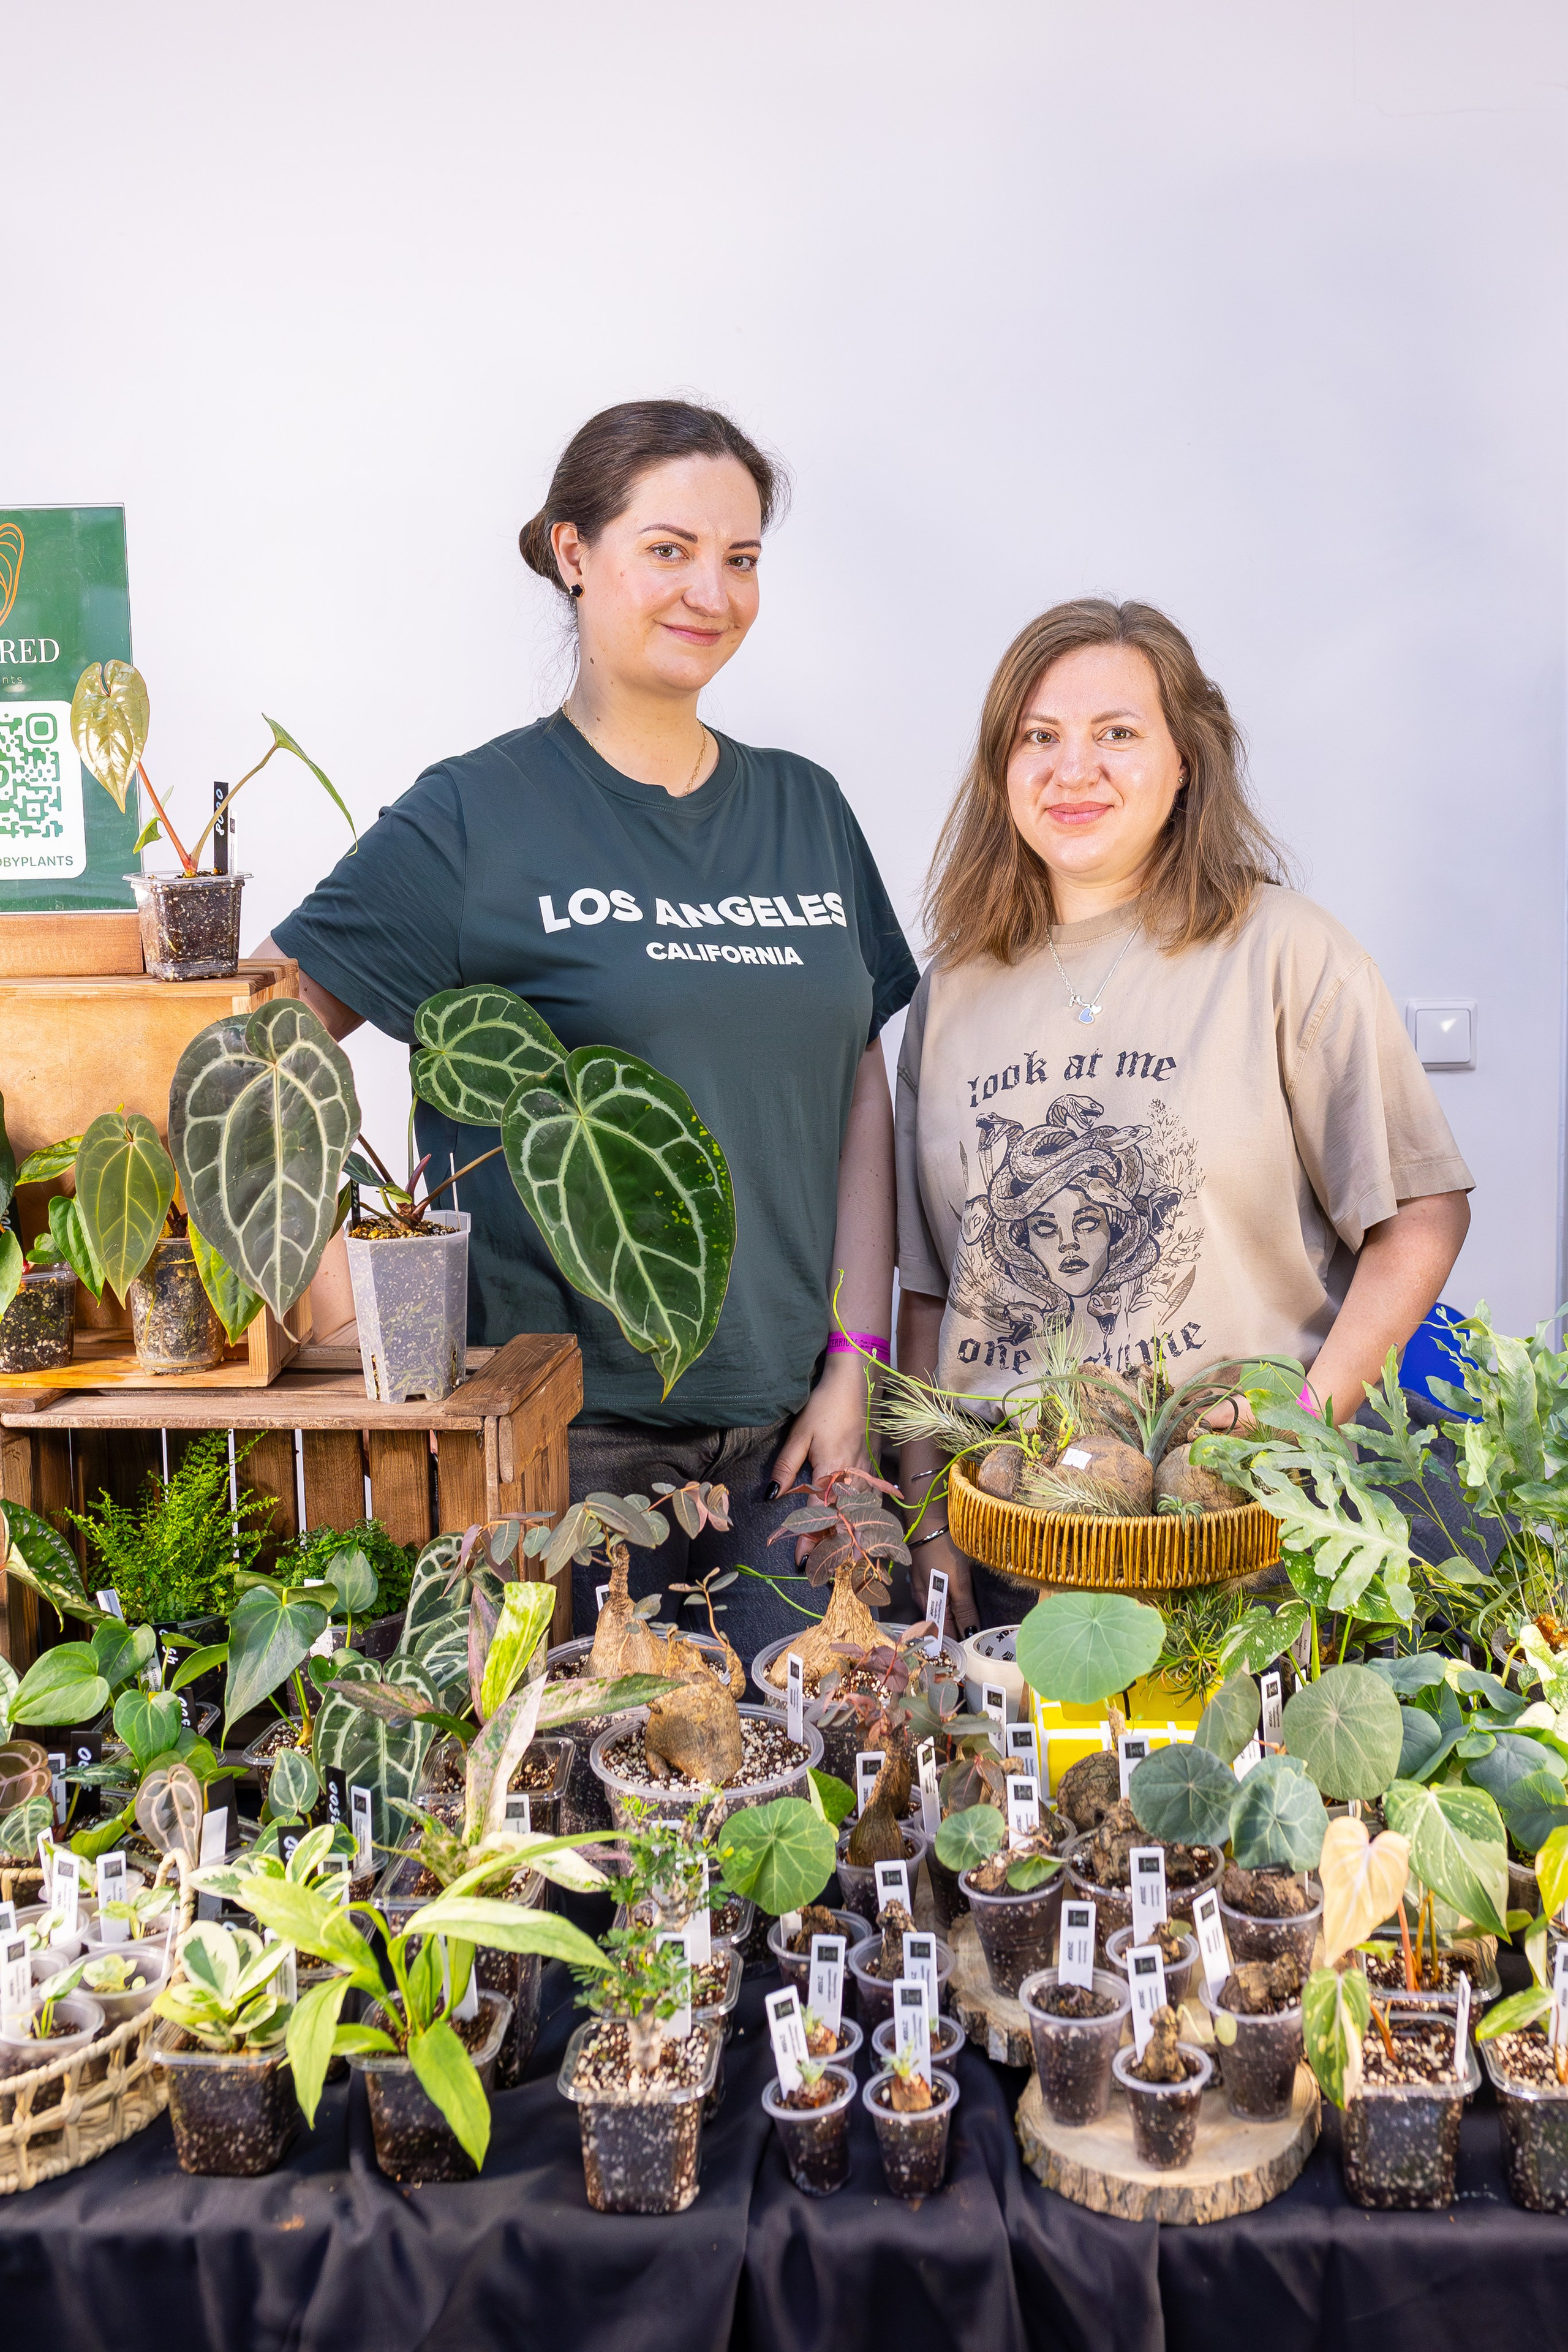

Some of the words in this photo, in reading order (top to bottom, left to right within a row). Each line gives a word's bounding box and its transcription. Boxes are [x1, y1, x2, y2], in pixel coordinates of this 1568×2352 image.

[0, 856, 74, 867] BYPLANTS
[538, 888, 643, 933] LOS
[655, 892, 847, 929] ANGELES
[646, 941, 804, 966] CALIFORNIA
[967, 1050, 1049, 1108] look
[1063, 1048, 1104, 1080] at
[1115, 1050, 1177, 1082] me
[957, 1337, 1033, 1376] one
[151, 1666, 159, 1692] Anthuriu
[328, 1781, 341, 1825] 3500
